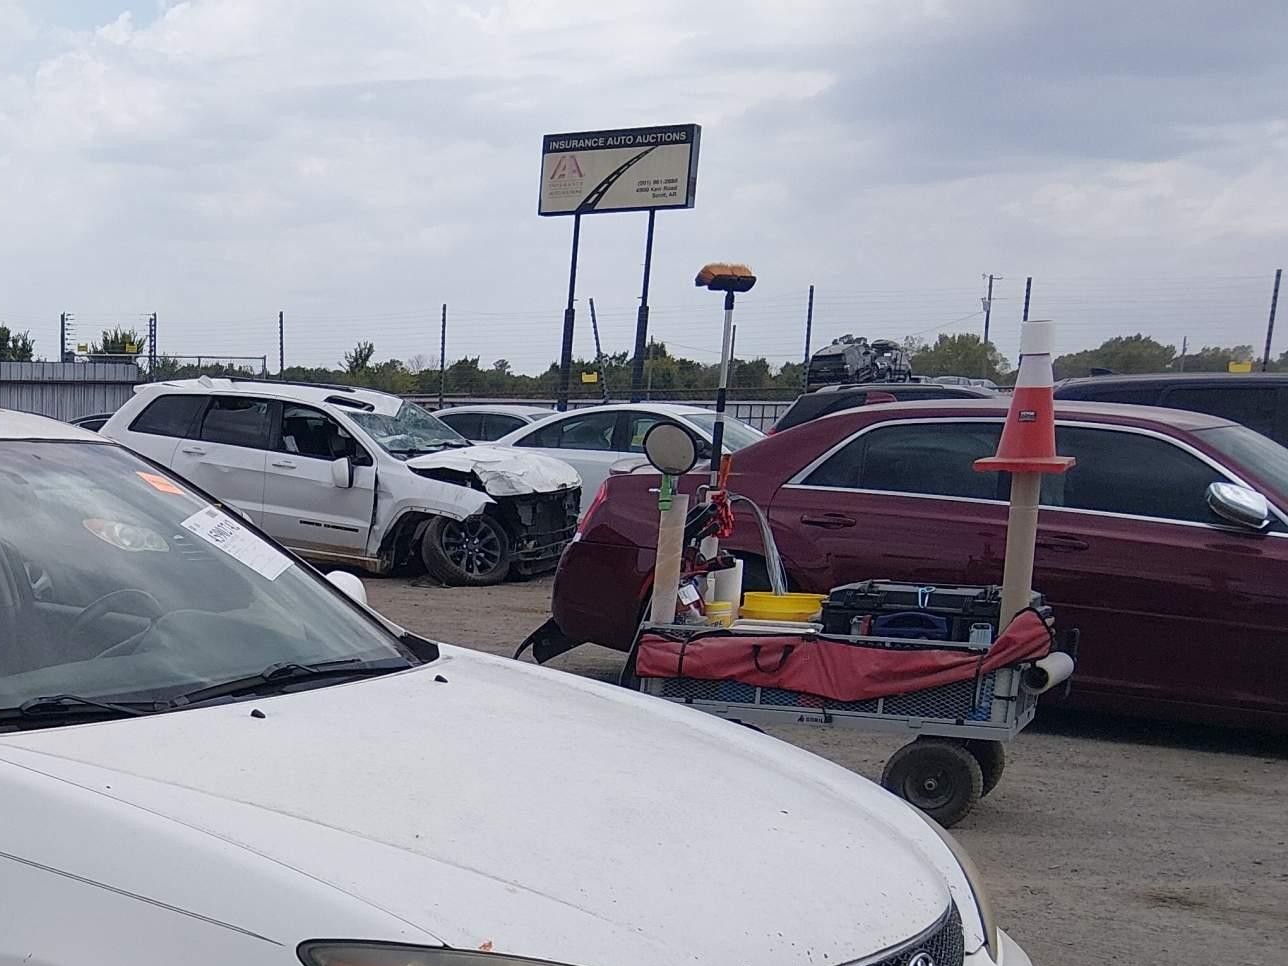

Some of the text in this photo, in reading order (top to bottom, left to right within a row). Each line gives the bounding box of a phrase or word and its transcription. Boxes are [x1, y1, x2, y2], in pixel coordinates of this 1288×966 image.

[549, 131, 687, 151] INSURANCE AUTO AUCTIONS
